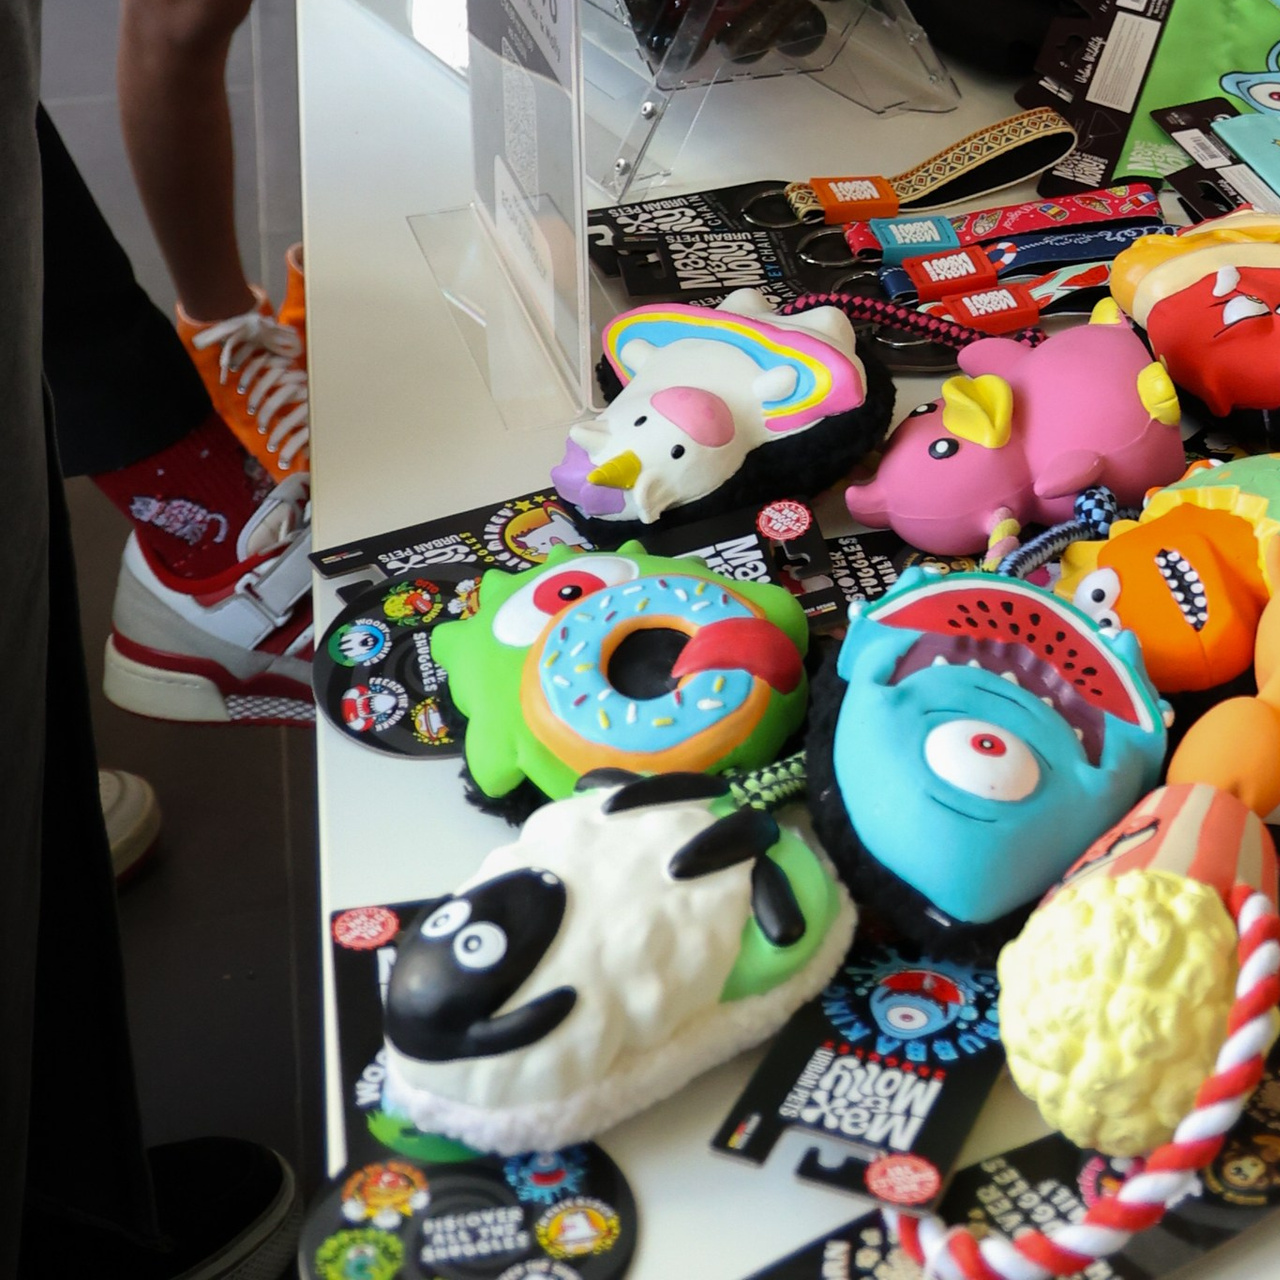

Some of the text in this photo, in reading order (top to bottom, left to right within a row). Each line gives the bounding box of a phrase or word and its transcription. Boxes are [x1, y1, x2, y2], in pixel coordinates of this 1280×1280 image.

[607, 197, 688, 218] URBAN PETS
[684, 194, 722, 227] CHAIN
[664, 232, 752, 245] URBAN PETS
[750, 231, 776, 262] CHAIN
[668, 243, 722, 289] Max
[706, 241, 769, 287] Molly
[689, 295, 722, 308] PETS
[413, 533, 461, 553] URBAN
[482, 508, 515, 552] MIKEY
[768, 520, 789, 533] TOY
[377, 544, 412, 564] PETS
[714, 533, 771, 583] Ma
[837, 536, 884, 596] TUGGLES
[828, 550, 867, 603] SCOVER
[411, 631, 439, 693] SNUGGLES
[777, 1046, 836, 1120] URBAN PETS
[819, 1055, 944, 1118] Molly
[800, 1088, 924, 1152] Max
[422, 1205, 524, 1235] DISCOVER
[419, 1230, 531, 1264] SNUGGLES
